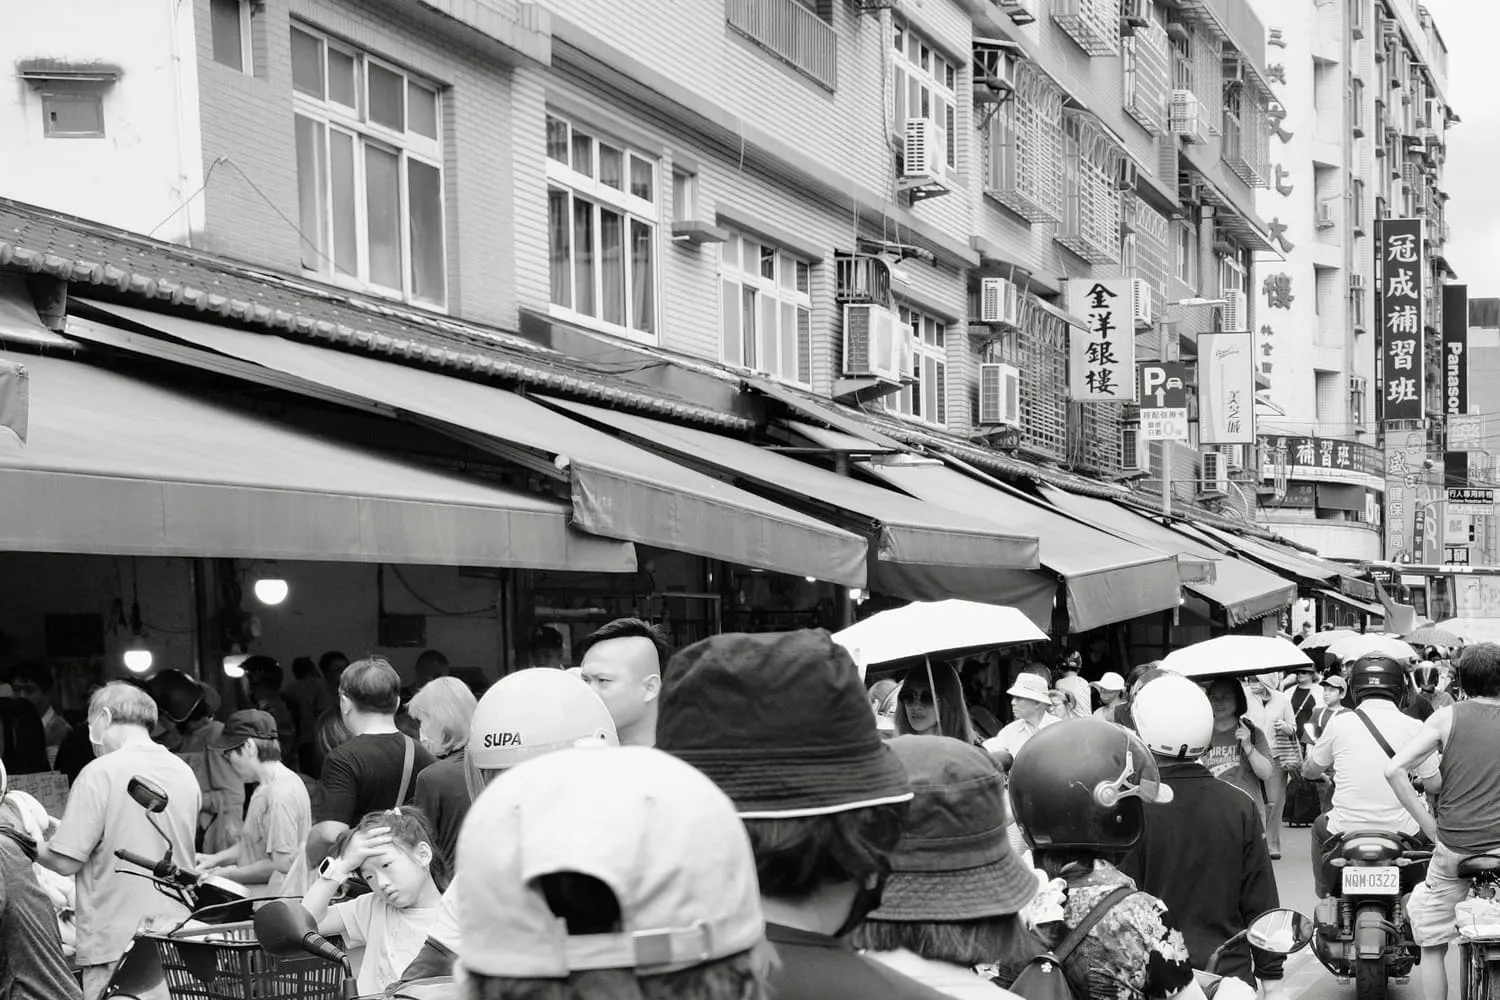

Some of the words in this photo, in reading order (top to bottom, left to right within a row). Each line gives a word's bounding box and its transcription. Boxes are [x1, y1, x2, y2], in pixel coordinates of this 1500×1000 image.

[1387, 234, 1418, 404] 冠成補習班
[1085, 283, 1120, 396] 金洋銀樓
[1144, 367, 1166, 396] P
[1296, 440, 1350, 468] 補習班
[484, 732, 522, 748] SUPA
